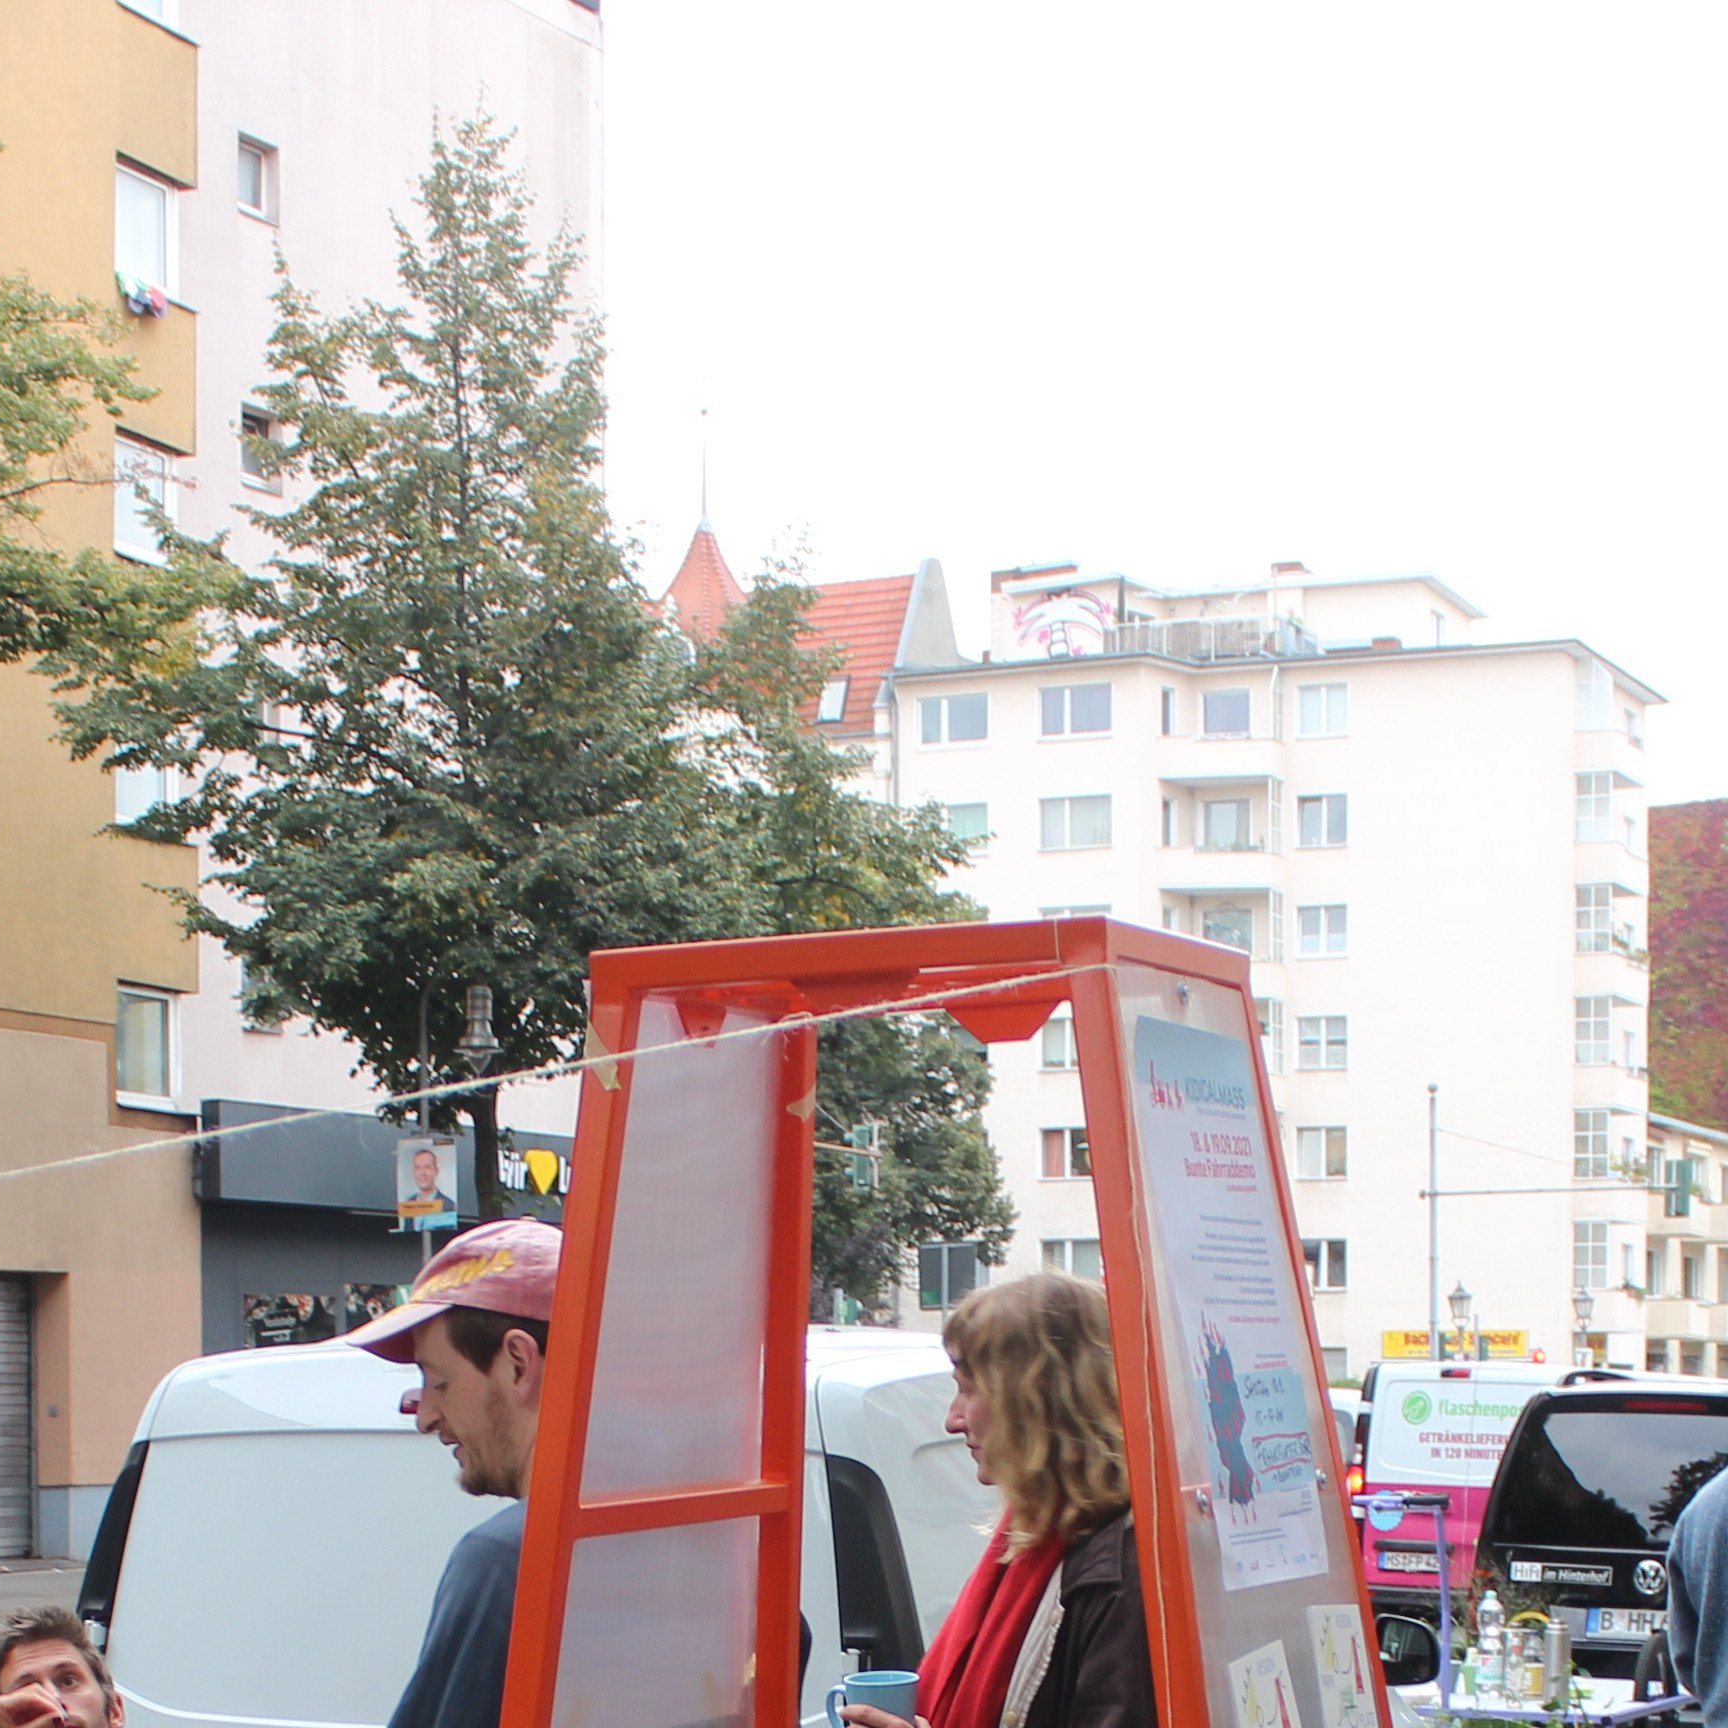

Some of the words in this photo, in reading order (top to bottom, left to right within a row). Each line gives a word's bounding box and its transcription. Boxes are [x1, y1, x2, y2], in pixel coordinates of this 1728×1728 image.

[1430, 1447, 1443, 1458] IN
[1445, 1447, 1462, 1459] 120
[1513, 1564, 1541, 1579] HiFi
[1557, 1568, 1611, 1584] Hinterhof
[1601, 1611, 1614, 1631] B
[1628, 1613, 1654, 1633] HH
